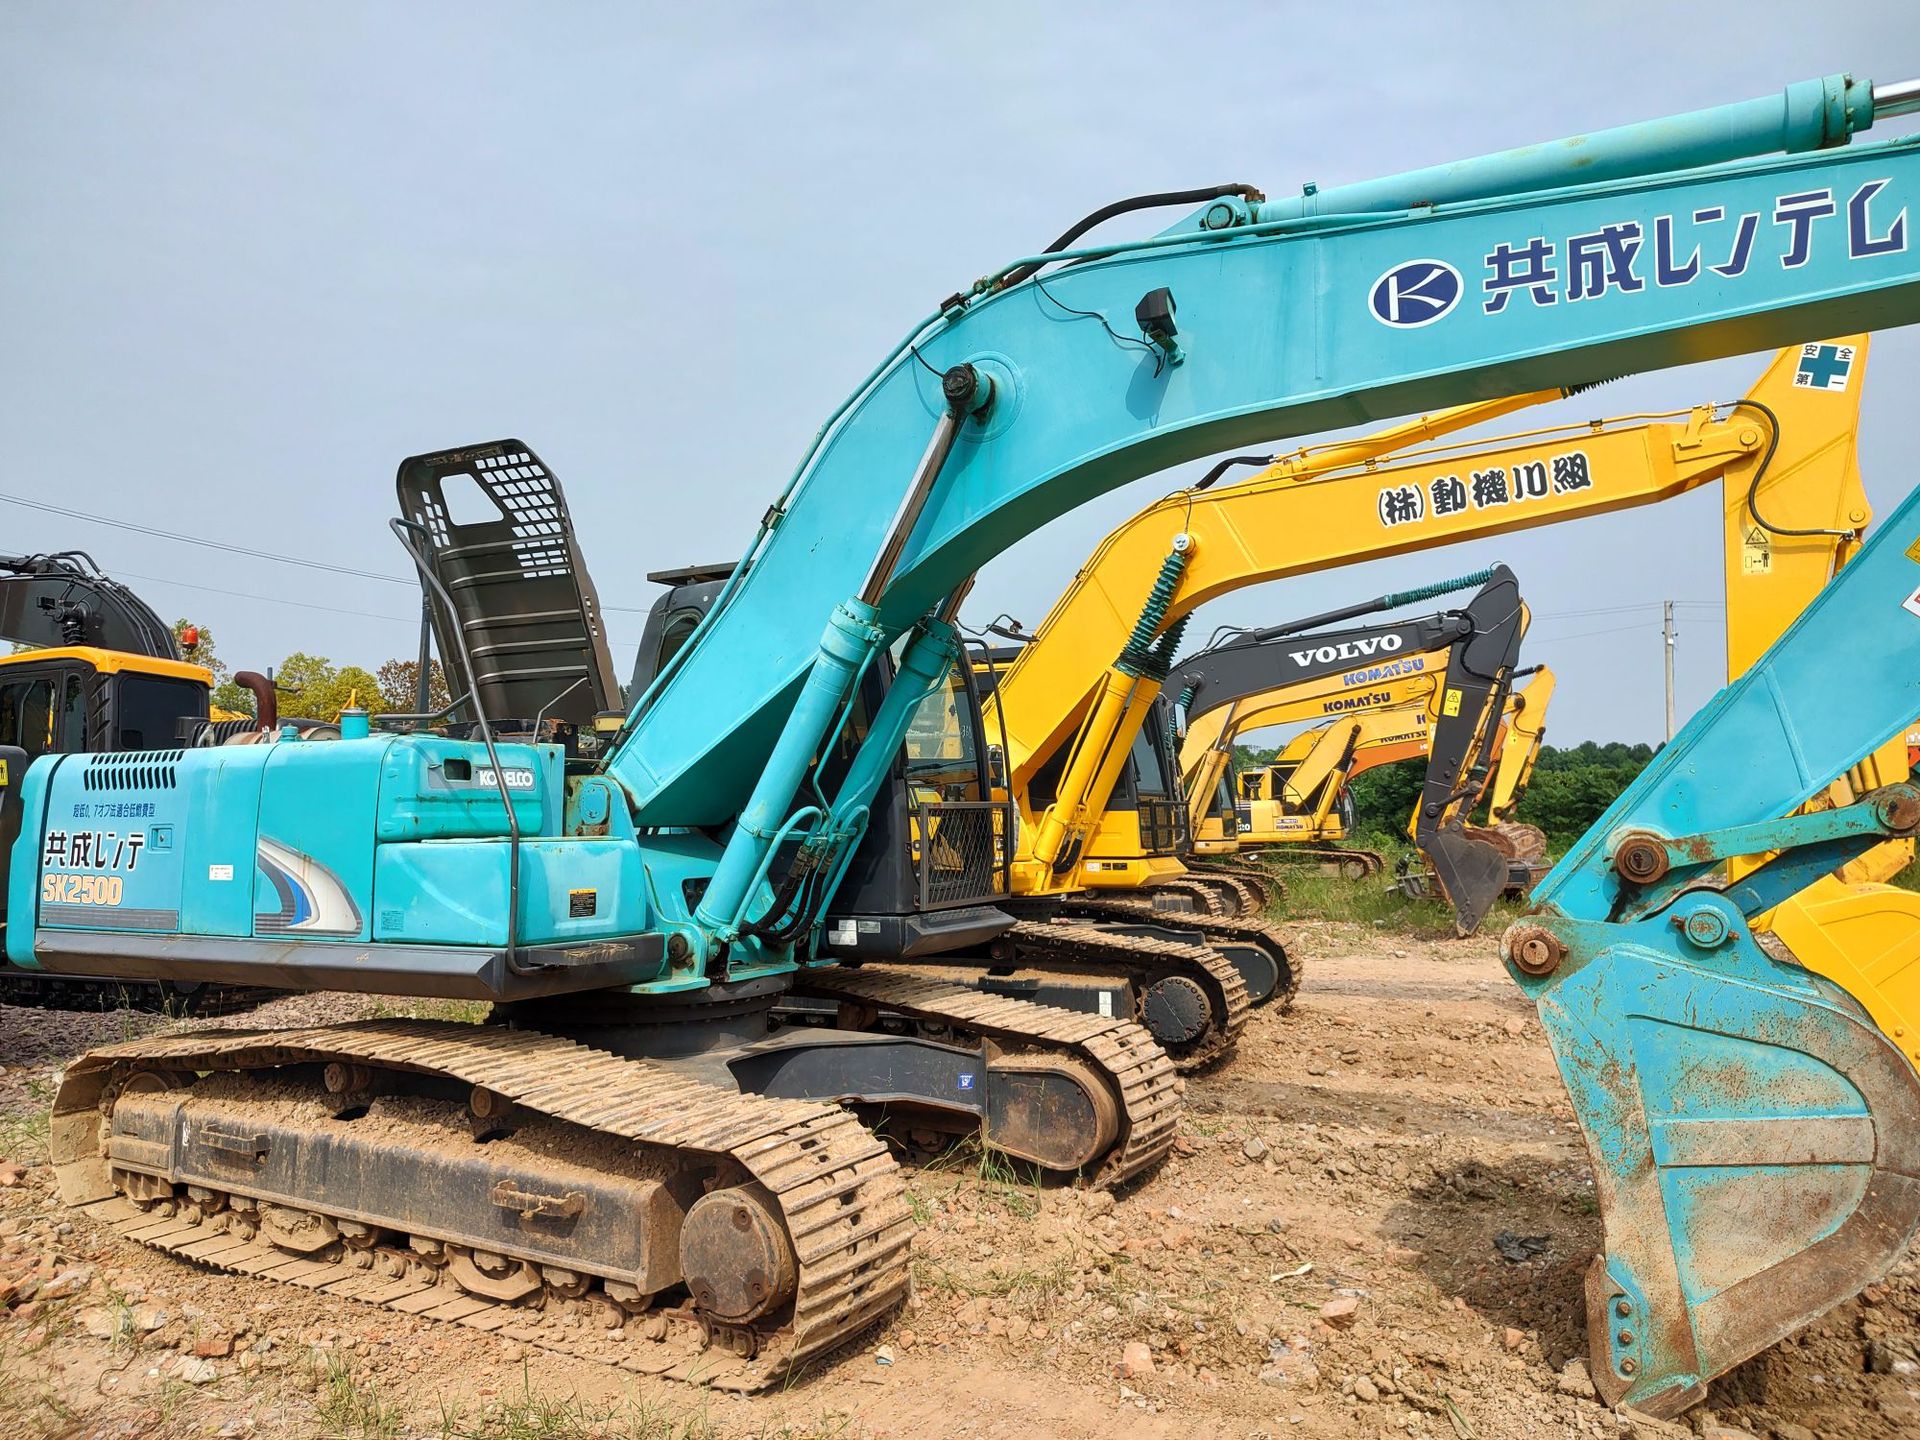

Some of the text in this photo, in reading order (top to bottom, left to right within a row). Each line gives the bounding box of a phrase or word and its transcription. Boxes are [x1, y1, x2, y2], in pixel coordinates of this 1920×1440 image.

[1288, 634, 1403, 667] VOLVO
[1343, 658, 1425, 686] KOMATSU
[1323, 692, 1391, 713] KOMATSU
[480, 770, 532, 787] KOELCO
[44, 831, 144, 870] 共成レンテ
